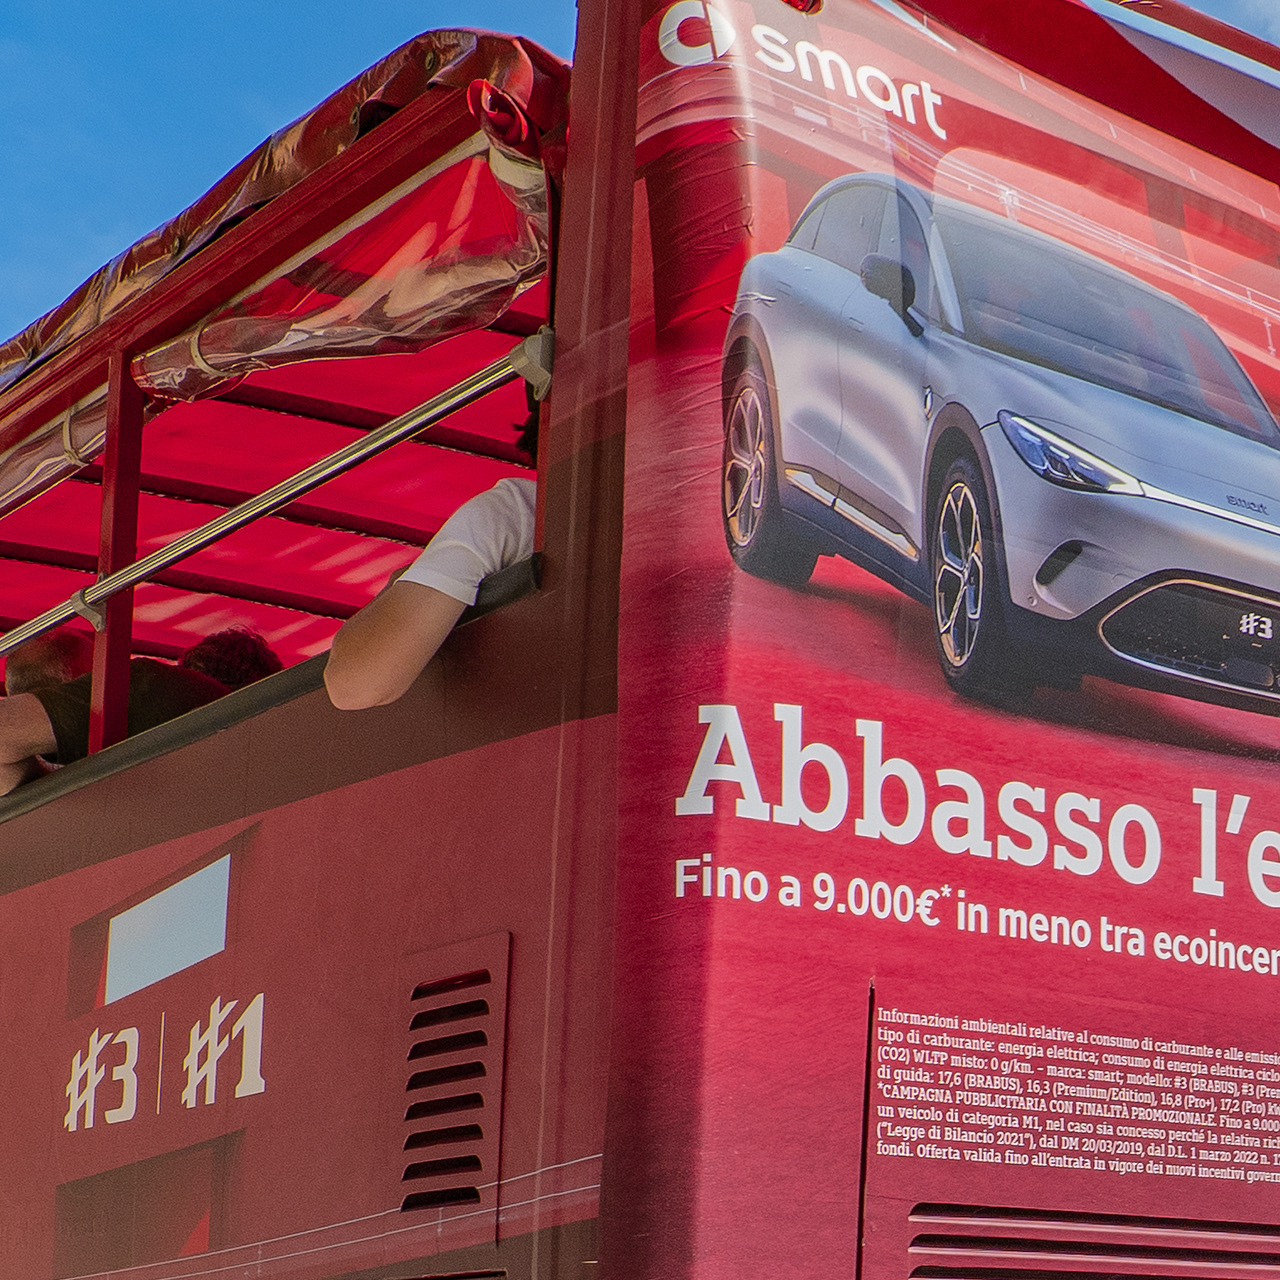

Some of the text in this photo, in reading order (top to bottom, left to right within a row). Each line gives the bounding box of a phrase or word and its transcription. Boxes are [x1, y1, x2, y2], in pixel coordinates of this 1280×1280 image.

[751, 24, 947, 140] smart
[1239, 612, 1274, 640] #3
[675, 703, 1162, 885] Abbasso
[675, 854, 768, 902] Fino
[778, 875, 801, 907] a
[957, 890, 988, 934] in
[998, 907, 1092, 949] meno
[1100, 917, 1145, 957] tra
[180, 992, 266, 1109] #1
[877, 1008, 959, 1028] Informazioni
[961, 1019, 1027, 1036] ambientali
[1029, 1025, 1074, 1041] relative
[1076, 1030, 1088, 1043] al
[1089, 1034, 1139, 1048] consumo
[1141, 1037, 1153, 1050] di
[1154, 1041, 1213, 1056] carburante
[1215, 1048, 1222, 1058] e
[1223, 1047, 1243, 1060] alle
[877, 1026, 903, 1044] tipo
[906, 1029, 920, 1043] di
[923, 1033, 994, 1050] carburante:
[998, 1042, 1043, 1058] energia
[1046, 1045, 1099, 1064] elettrica;
[1101, 1054, 1150, 1067] consumo
[1153, 1056, 1164, 1069] di
[1167, 1061, 1208, 1075] energia
[1210, 1063, 1254, 1078] elettrica
[64, 1026, 140, 1133] #3
[877, 1046, 910, 1064] (CO2)
[912, 1049, 948, 1064] WLTP
[950, 1054, 988, 1068] misto:
[990, 1057, 998, 1070] 0
[1000, 1058, 1034, 1074] g/km.
[1046, 1065, 1085, 1078] marca:
[1087, 1070, 1124, 1084] smart;
[1126, 1073, 1172, 1087] modello:
[1174, 1075, 1187, 1088] #3
[1189, 1078, 1240, 1096] (BRABUS),
[1241, 1082, 1254, 1095] #3
[877, 1064, 890, 1078] di
[893, 1067, 934, 1082] guida:
[938, 1071, 961, 1087] 17,6
[964, 1073, 1023, 1093] (BRABUS),
[1026, 1079, 1050, 1095] 16,3
[1052, 1082, 1157, 1105] (Premium/Edition),
[1160, 1092, 1182, 1107] 16,8
[1184, 1095, 1217, 1111] (Pro+),
[1220, 1098, 1239, 1112] 17,2
[876, 1105, 894, 1117] un
[897, 1105, 942, 1120] veicolo
[945, 1108, 959, 1122] di
[962, 1112, 1019, 1128] categoria
[1022, 1115, 1042, 1131] M1,
[1045, 1117, 1064, 1131] nel
[1067, 1122, 1093, 1133] caso
[1096, 1121, 1113, 1134] sia
[1116, 1126, 1165, 1138] concesso
[1168, 1129, 1204, 1142] perché
[1207, 1130, 1217, 1143] la
[1220, 1133, 1260, 1146] relativa
[955, 1091, 1047, 1110] PUBBLICITARIA
[1049, 1099, 1073, 1113] CON
[1075, 1102, 1129, 1118] FINALITÀ
[1131, 1107, 1217, 1125] PROMOZIONALE.
[1219, 1114, 1242, 1128] Fino
[1243, 1119, 1251, 1129] a
[876, 1140, 913, 1156] fondi.
[916, 1144, 960, 1159] Offerta
[963, 1148, 1001, 1162] valida
[1004, 1149, 1028, 1164] fino
[1093, 1156, 1105, 1170] in
[1108, 1158, 1143, 1174] vigore
[1145, 1160, 1163, 1173] dei
[1165, 1164, 1196, 1176] nuovi
[1198, 1164, 1244, 1179] incentivi
[928, 1125, 941, 1139] di
[944, 1127, 994, 1143] Bilancio
[1039, 1134, 1058, 1148] dal
[1061, 1136, 1079, 1149] DM
[1081, 1138, 1145, 1156] 20/03/2019,
[1147, 1142, 1165, 1156] dal
[1167, 1144, 1187, 1158] D.L.
[1190, 1147, 1196, 1159] 1
[1199, 1150, 1231, 1161] marzo
[1233, 1150, 1258, 1163] 2022
